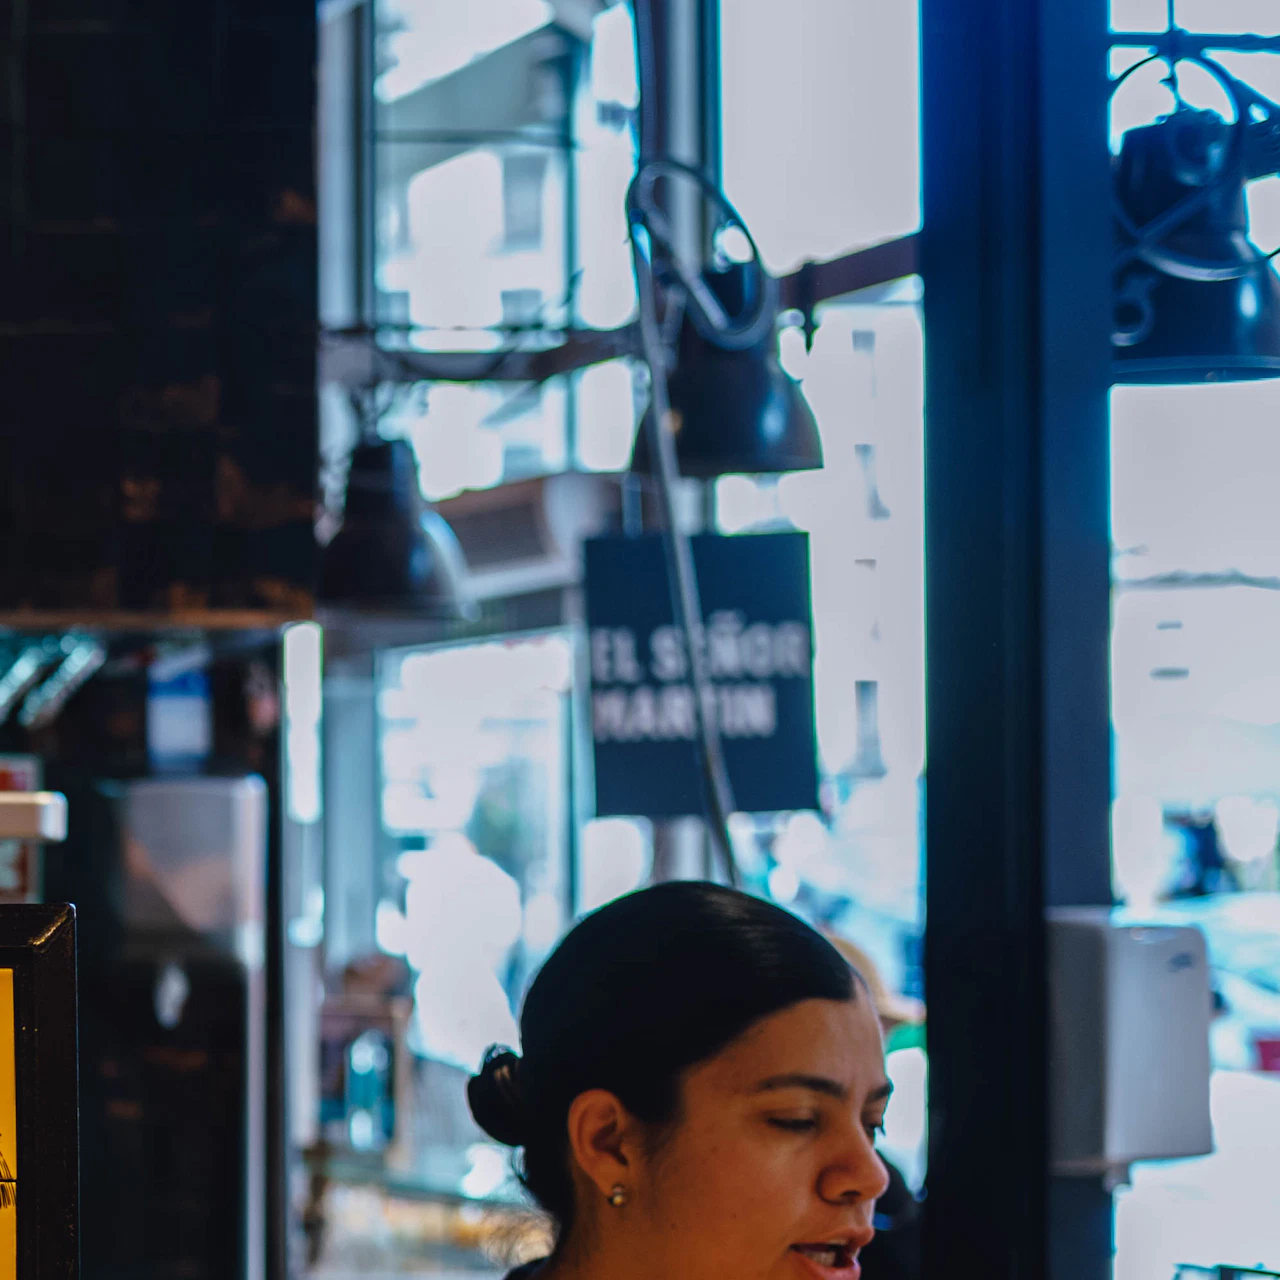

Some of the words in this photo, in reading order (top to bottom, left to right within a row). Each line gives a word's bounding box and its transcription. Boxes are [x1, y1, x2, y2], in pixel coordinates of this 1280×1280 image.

[591, 626, 640, 682] EL
[650, 609, 810, 680] SÑOR
[592, 683, 776, 742] MARIN
